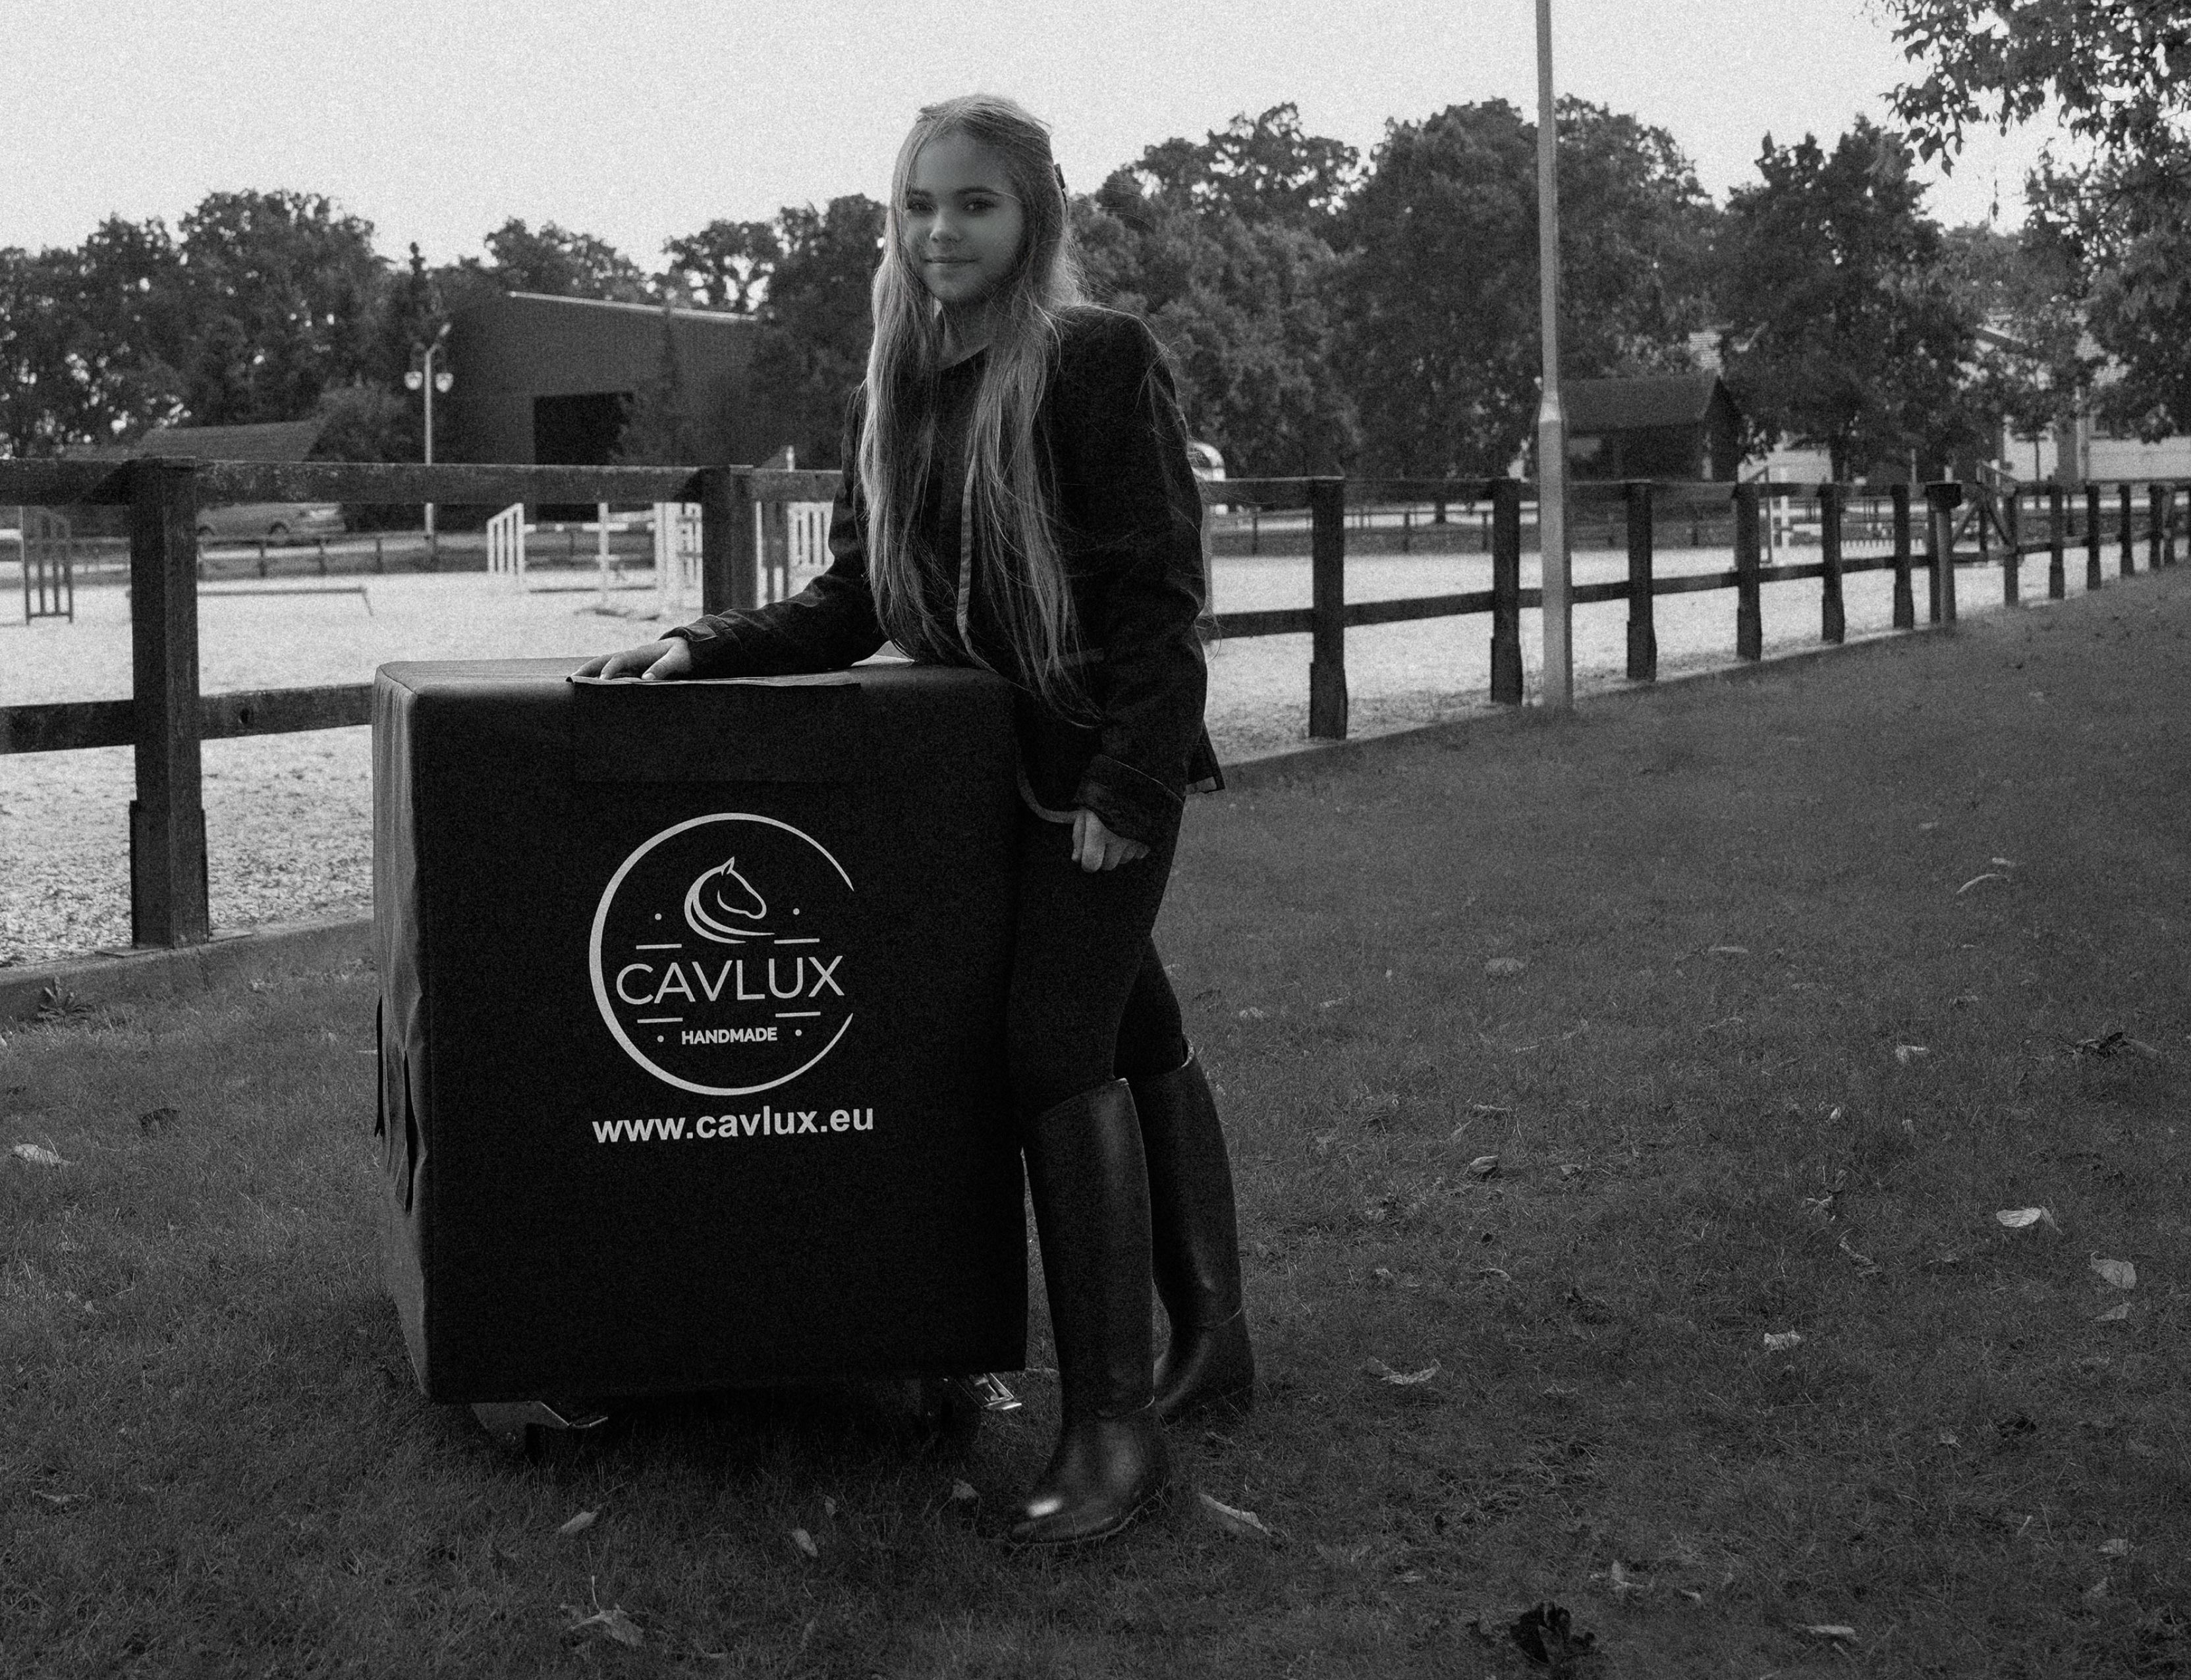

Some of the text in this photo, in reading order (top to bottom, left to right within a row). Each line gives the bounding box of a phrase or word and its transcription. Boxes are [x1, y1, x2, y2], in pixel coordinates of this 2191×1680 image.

[616, 955, 845, 1005] CAVLUX
[681, 1027, 778, 1044] HANDMADE
[592, 1105, 874, 1143] www.cavlux.eu
